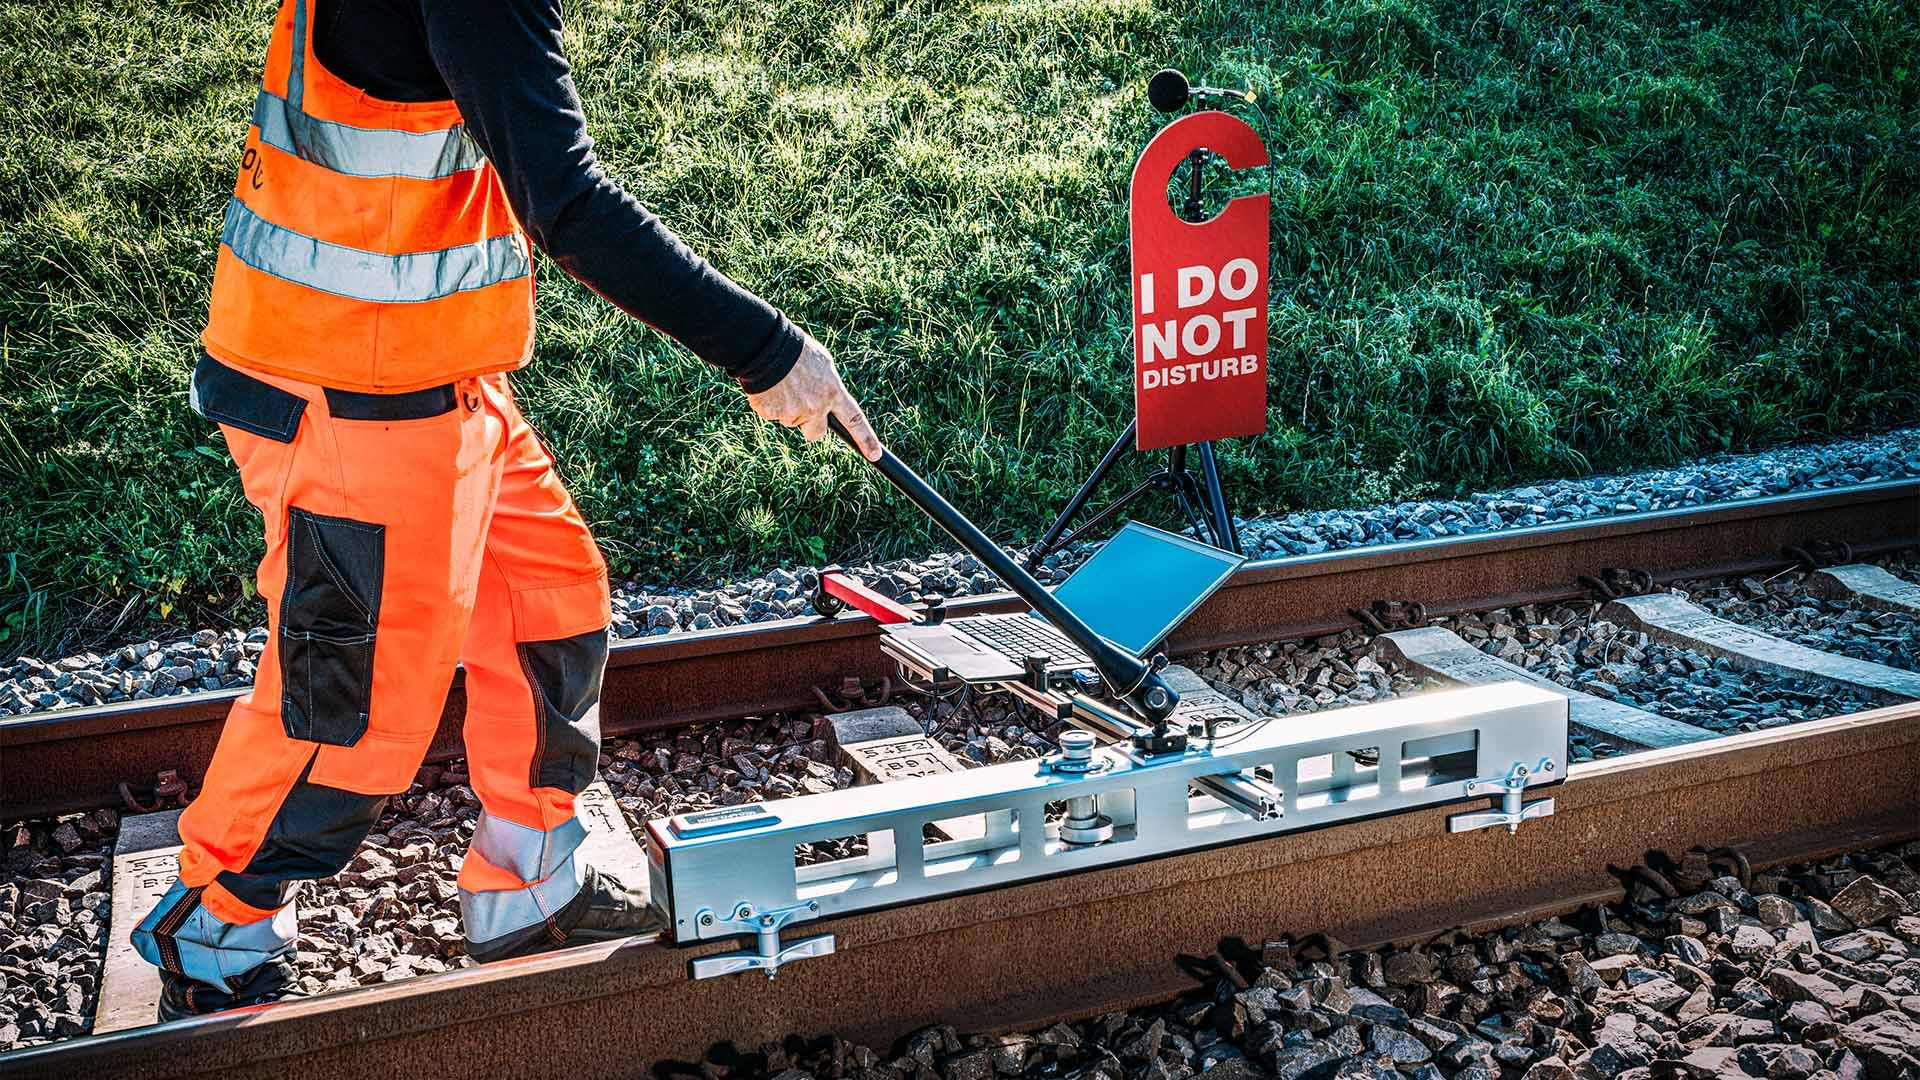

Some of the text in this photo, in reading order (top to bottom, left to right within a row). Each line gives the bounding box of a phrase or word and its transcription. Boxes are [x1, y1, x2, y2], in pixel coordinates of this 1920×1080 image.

[1140, 257, 1259, 315] I DO
[1142, 307, 1257, 363] NOT
[1143, 354, 1258, 390] DISTURB
